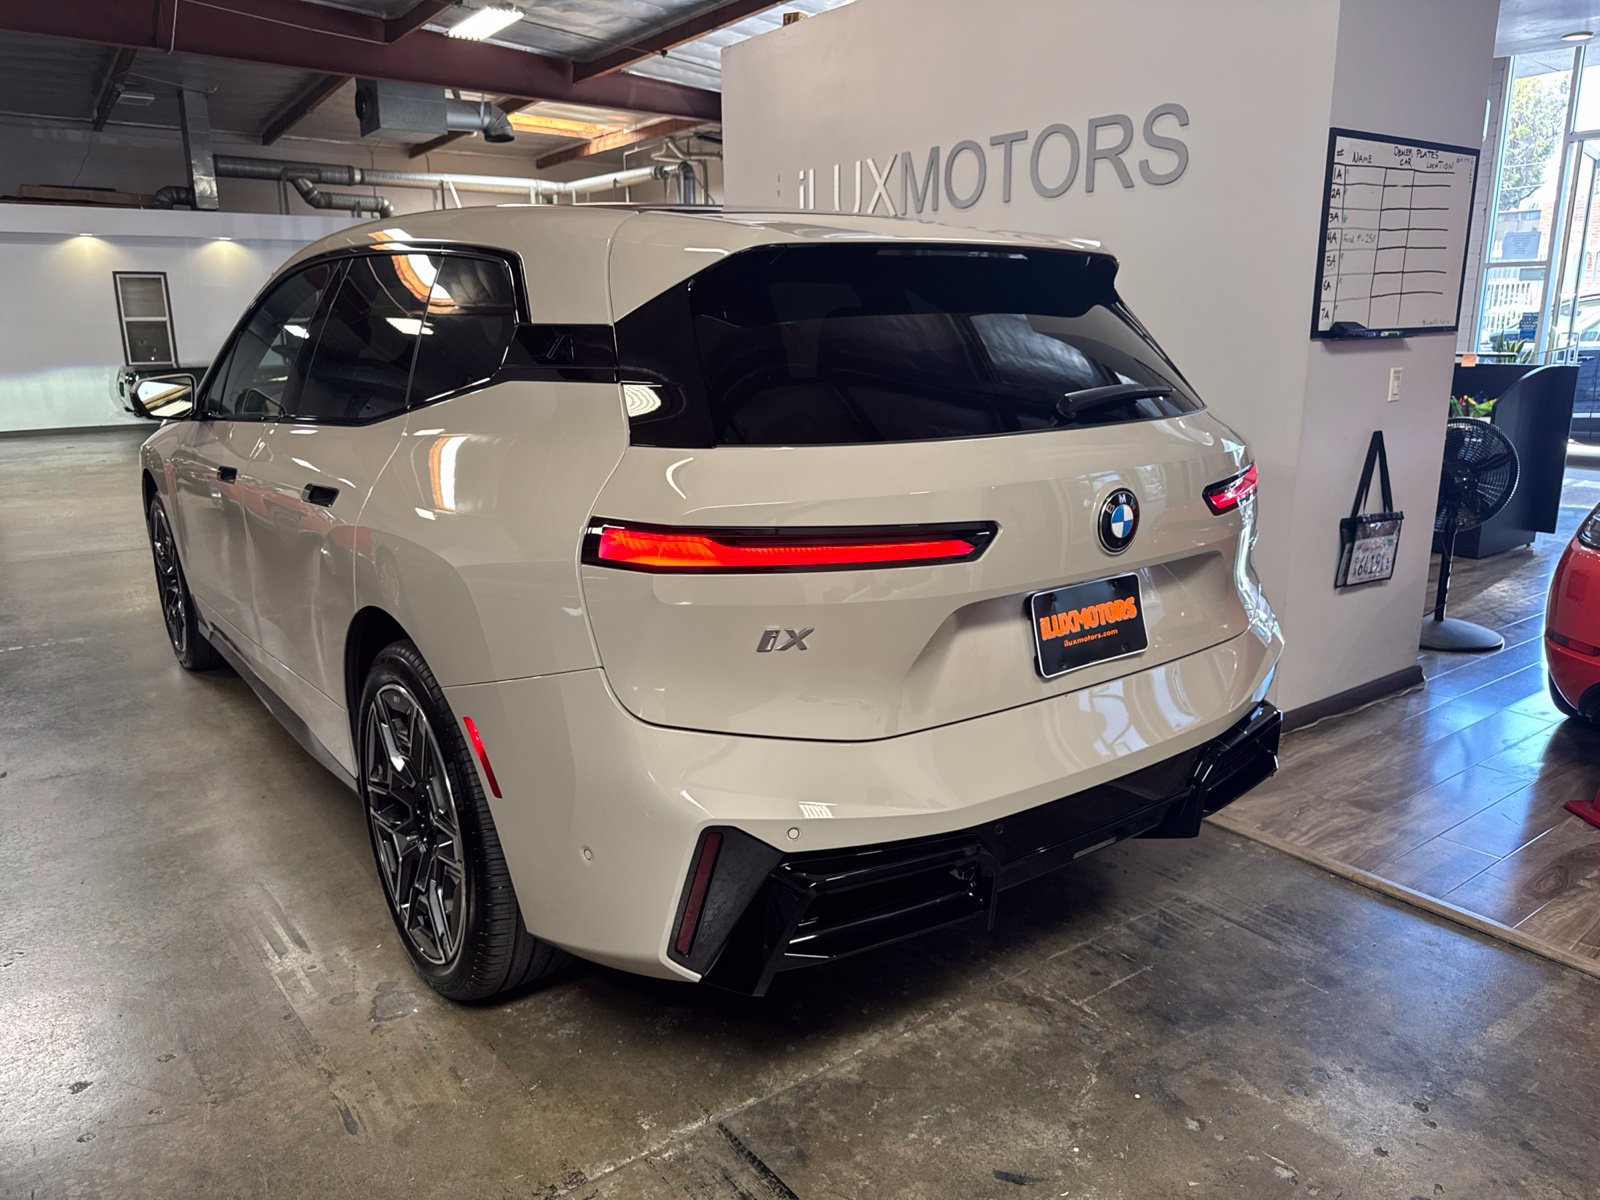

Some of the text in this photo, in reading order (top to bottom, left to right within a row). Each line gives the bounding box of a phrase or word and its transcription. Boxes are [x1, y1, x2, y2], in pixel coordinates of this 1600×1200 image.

[1352, 152, 1372, 163] NAME
[1416, 148, 1439, 160] PLATES
[1399, 159, 1412, 167] CAR
[1426, 161, 1455, 170] LOCATION
[1331, 188, 1341, 199] 2A
[1329, 212, 1339, 223] 3A
[1326, 255, 1336, 267] 5A
[1105, 493, 1137, 514] BMW
[756, 627, 815, 653] iX
[1063, 628, 1119, 648] iluxmotors.com
